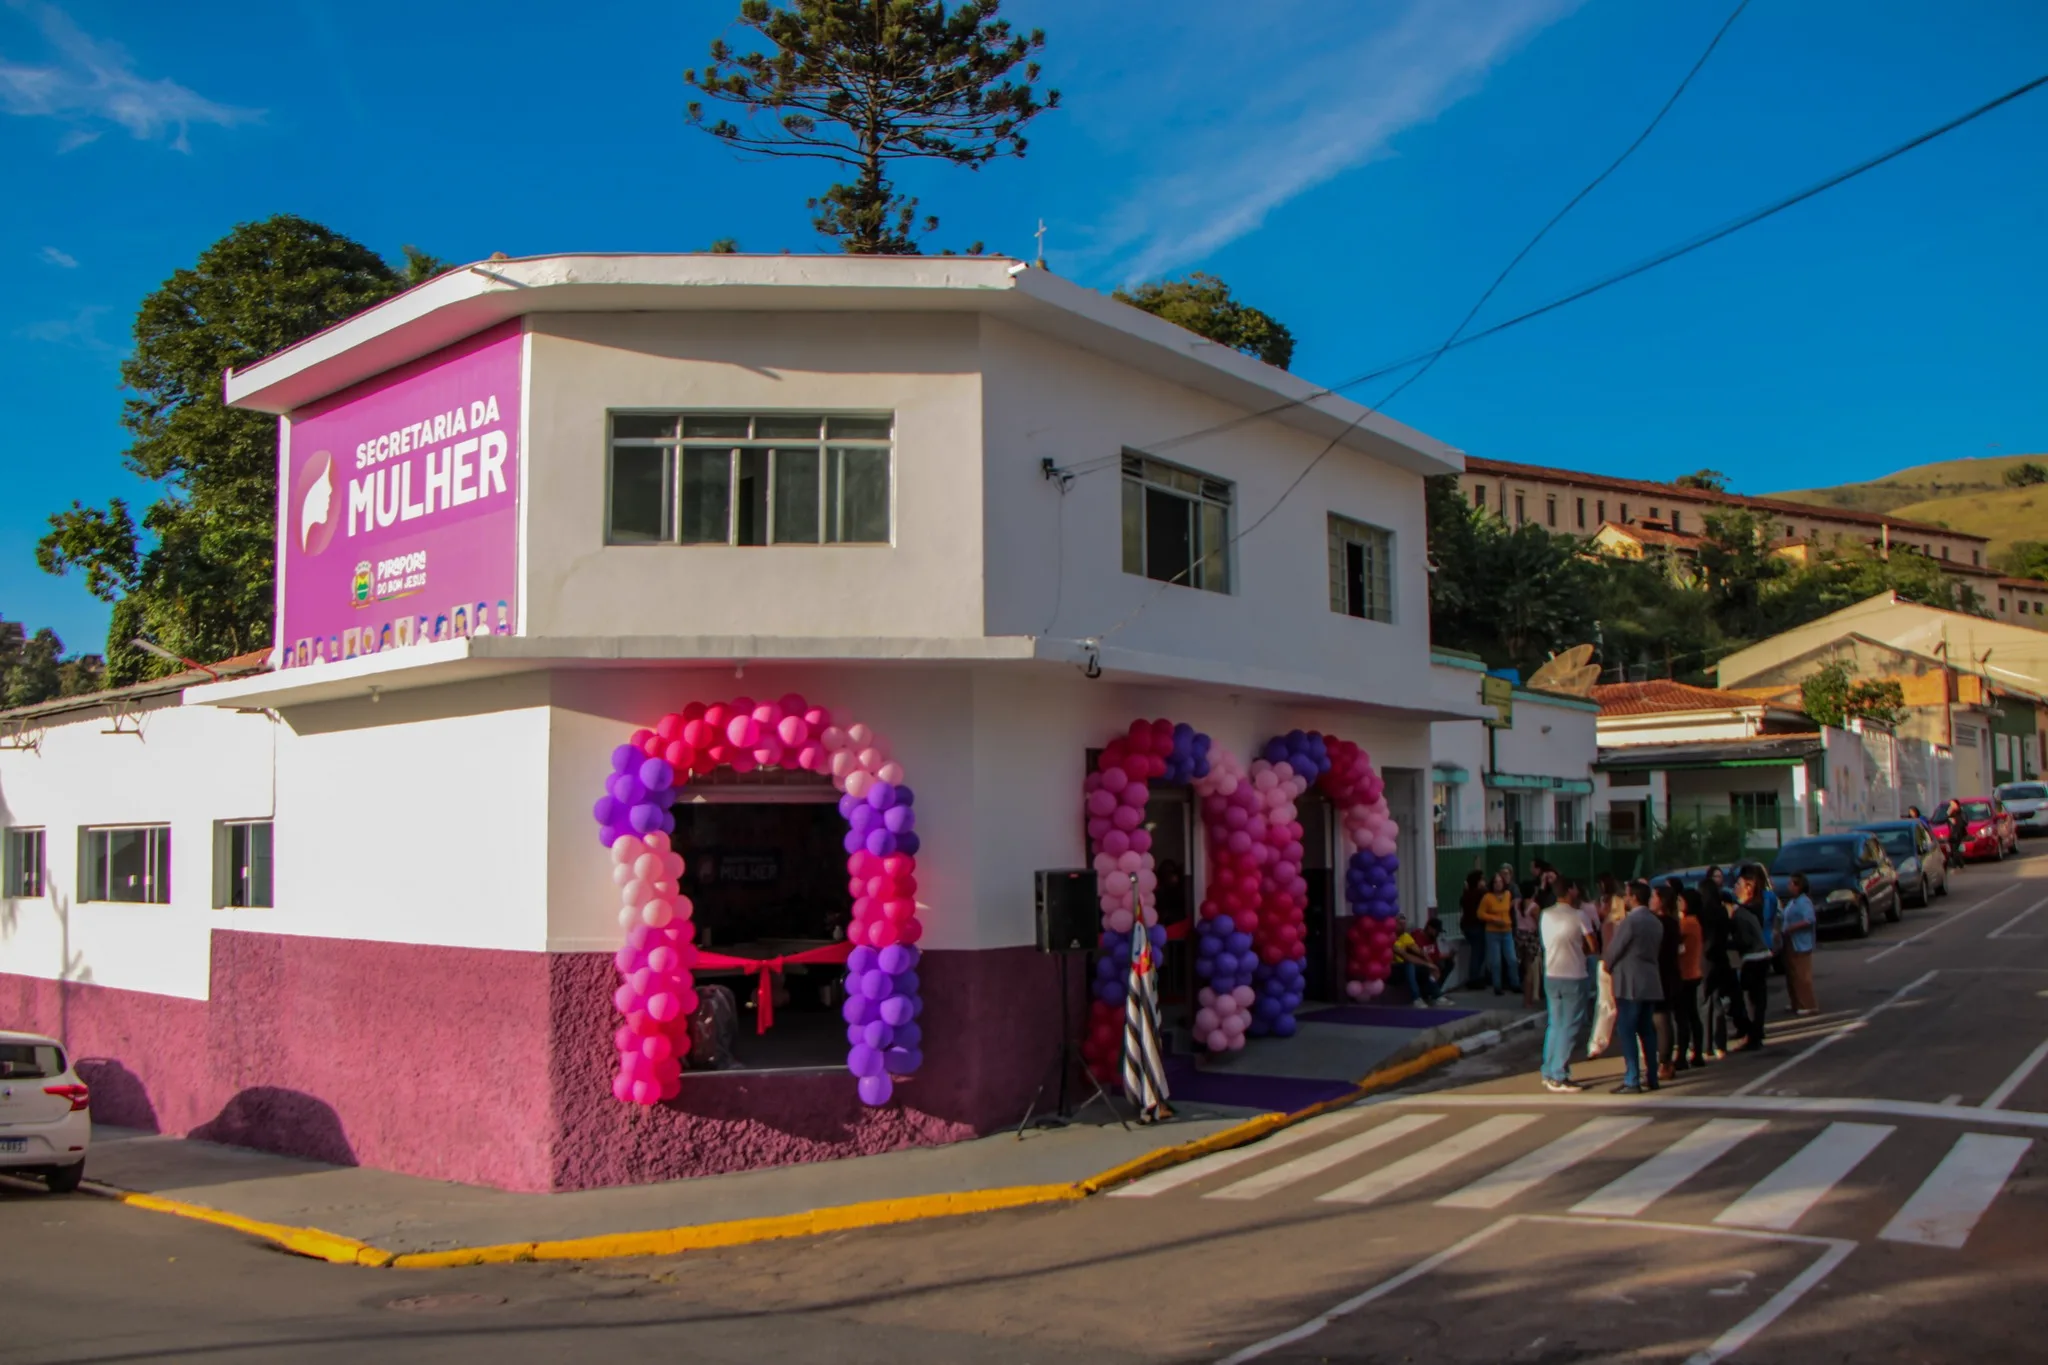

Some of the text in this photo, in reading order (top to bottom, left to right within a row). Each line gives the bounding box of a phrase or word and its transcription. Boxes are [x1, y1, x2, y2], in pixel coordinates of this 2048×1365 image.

[356, 395, 500, 469] SECRETARIA DA
[348, 430, 507, 537] MULHER
[377, 572, 426, 595] DO BOM JESUS
